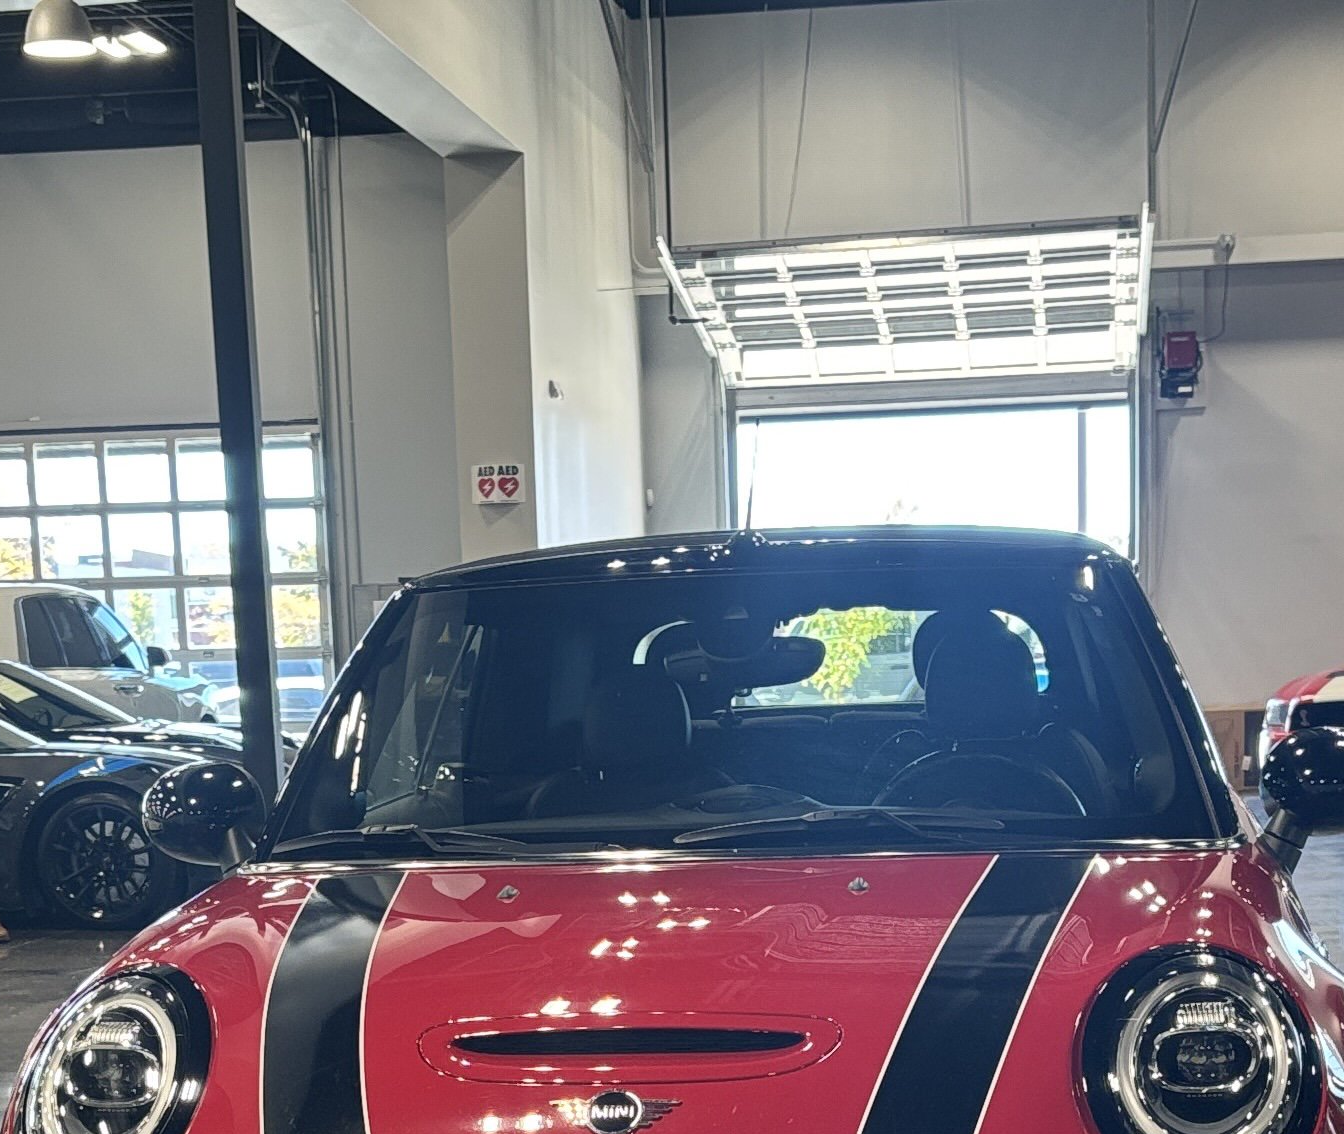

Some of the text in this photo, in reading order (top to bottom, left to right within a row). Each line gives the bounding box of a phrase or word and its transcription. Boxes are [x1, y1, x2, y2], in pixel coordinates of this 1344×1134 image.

[477, 465, 519, 477] AED AED
[591, 1104, 635, 1120] MINI
